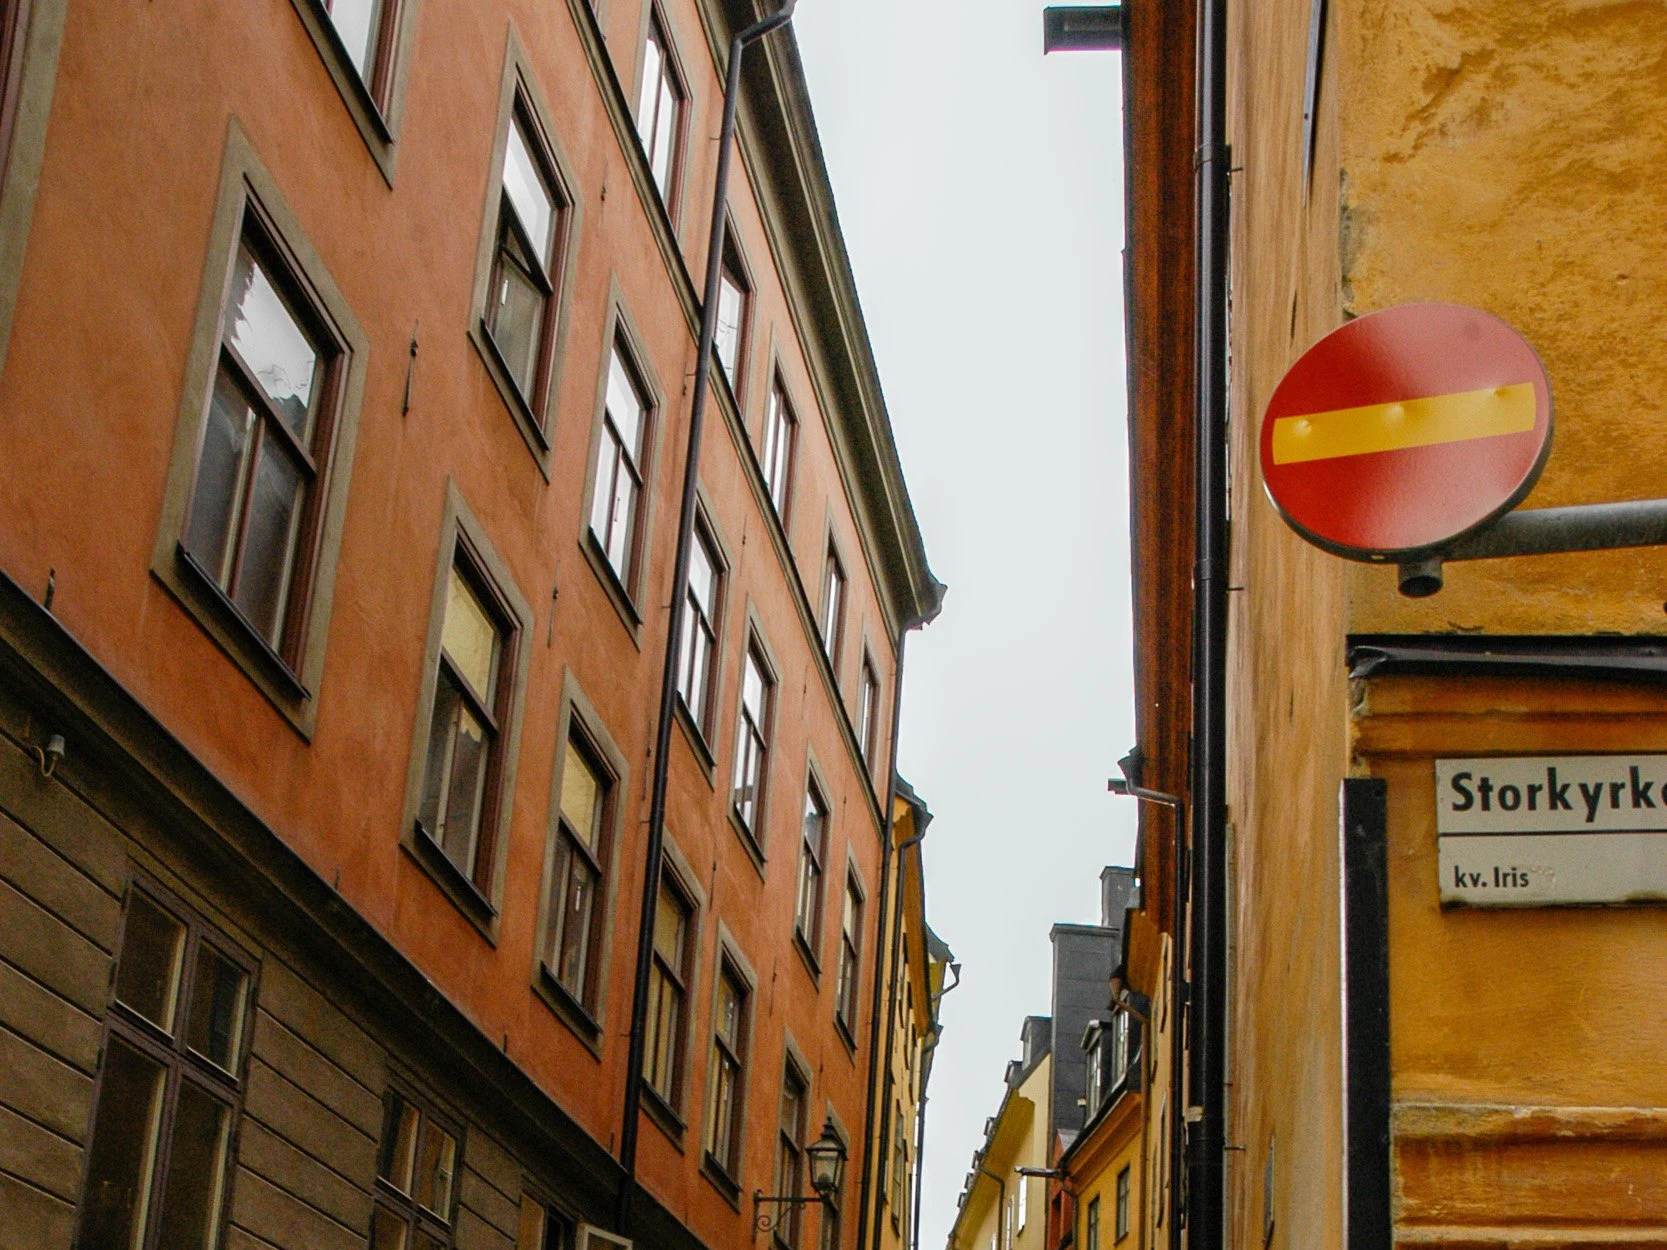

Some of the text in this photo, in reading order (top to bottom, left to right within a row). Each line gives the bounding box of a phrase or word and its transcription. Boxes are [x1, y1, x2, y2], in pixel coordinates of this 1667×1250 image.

[1451, 766, 1667, 822] Storkyrk
[1454, 865, 1529, 888] kv. Iris
